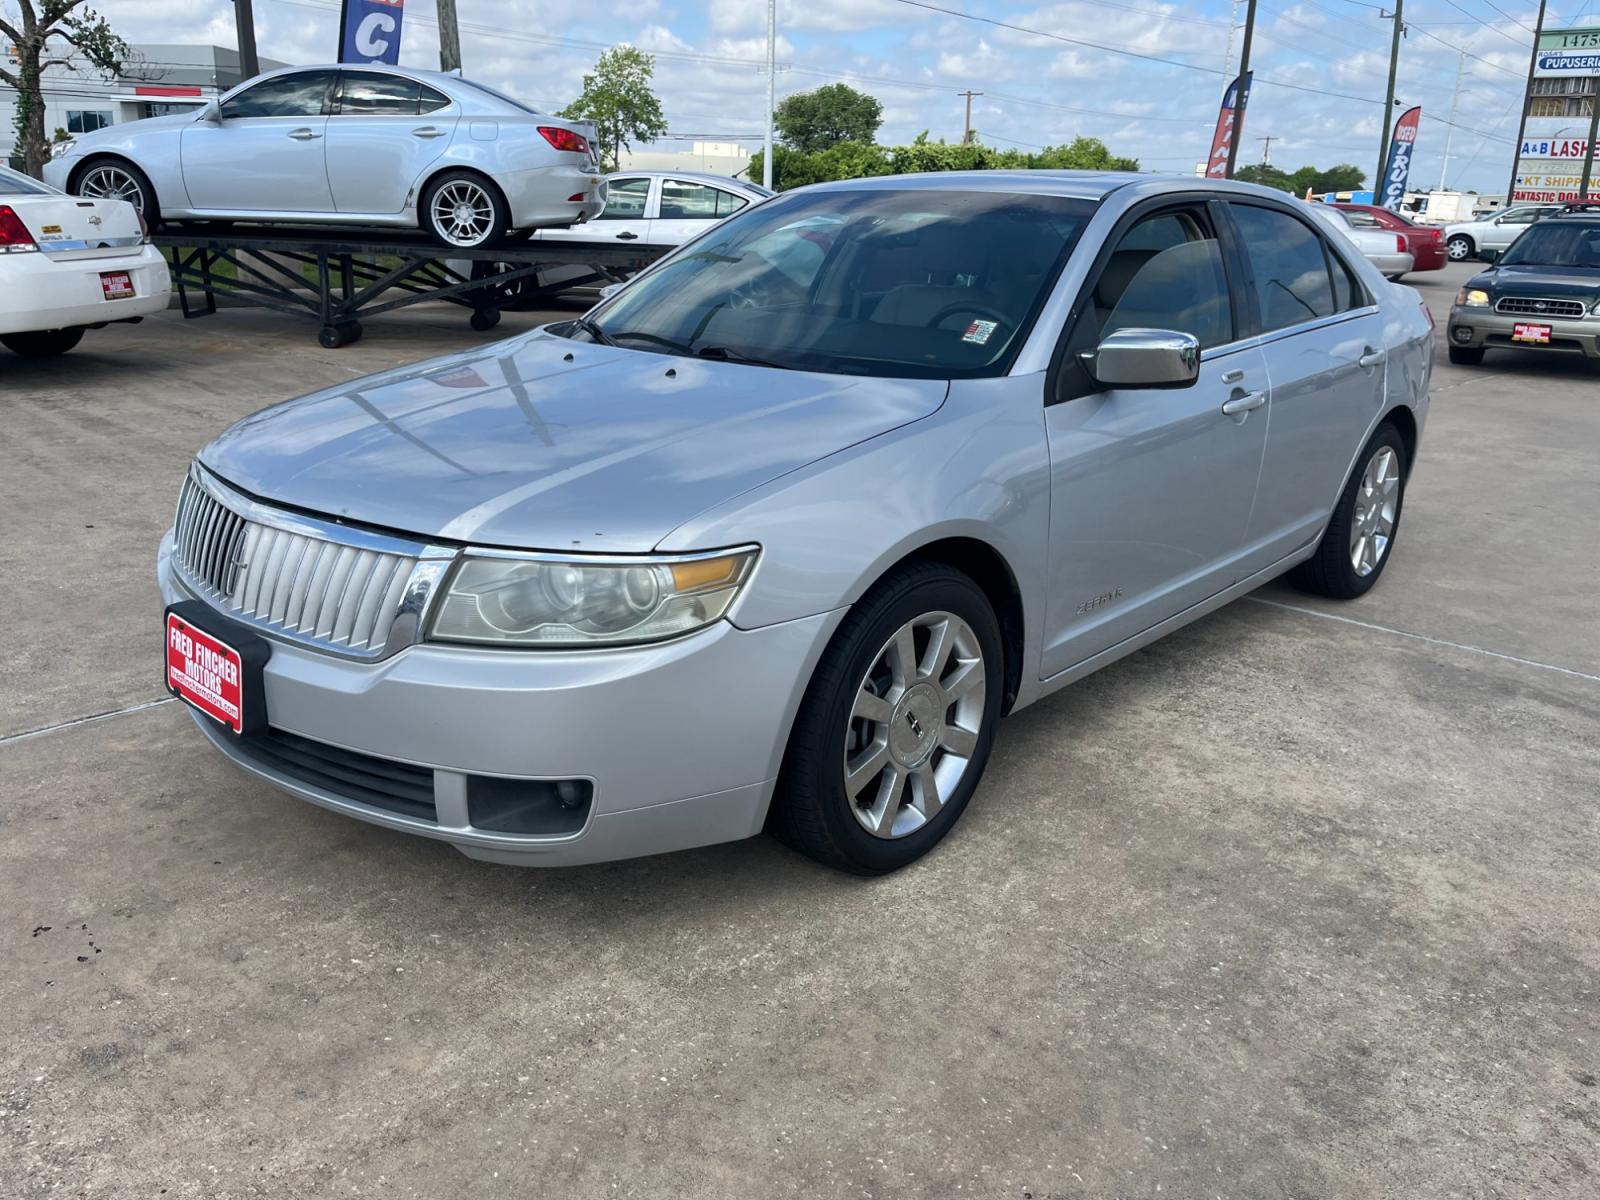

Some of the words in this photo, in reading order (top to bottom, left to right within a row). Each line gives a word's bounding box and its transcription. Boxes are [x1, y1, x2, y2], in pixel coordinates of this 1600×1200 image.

[355, 12, 395, 64] C
[1562, 34, 1600, 47] 1475
[1521, 142, 1530, 154] A
[1531, 144, 1538, 153] &
[1540, 142, 1549, 154] B
[1524, 176, 1542, 186] KT
[1513, 191, 1556, 202] FANTASTIC
[170, 627, 194, 658] FRED
[195, 642, 238, 687] FINCHER
[184, 657, 223, 696] MOTORS
